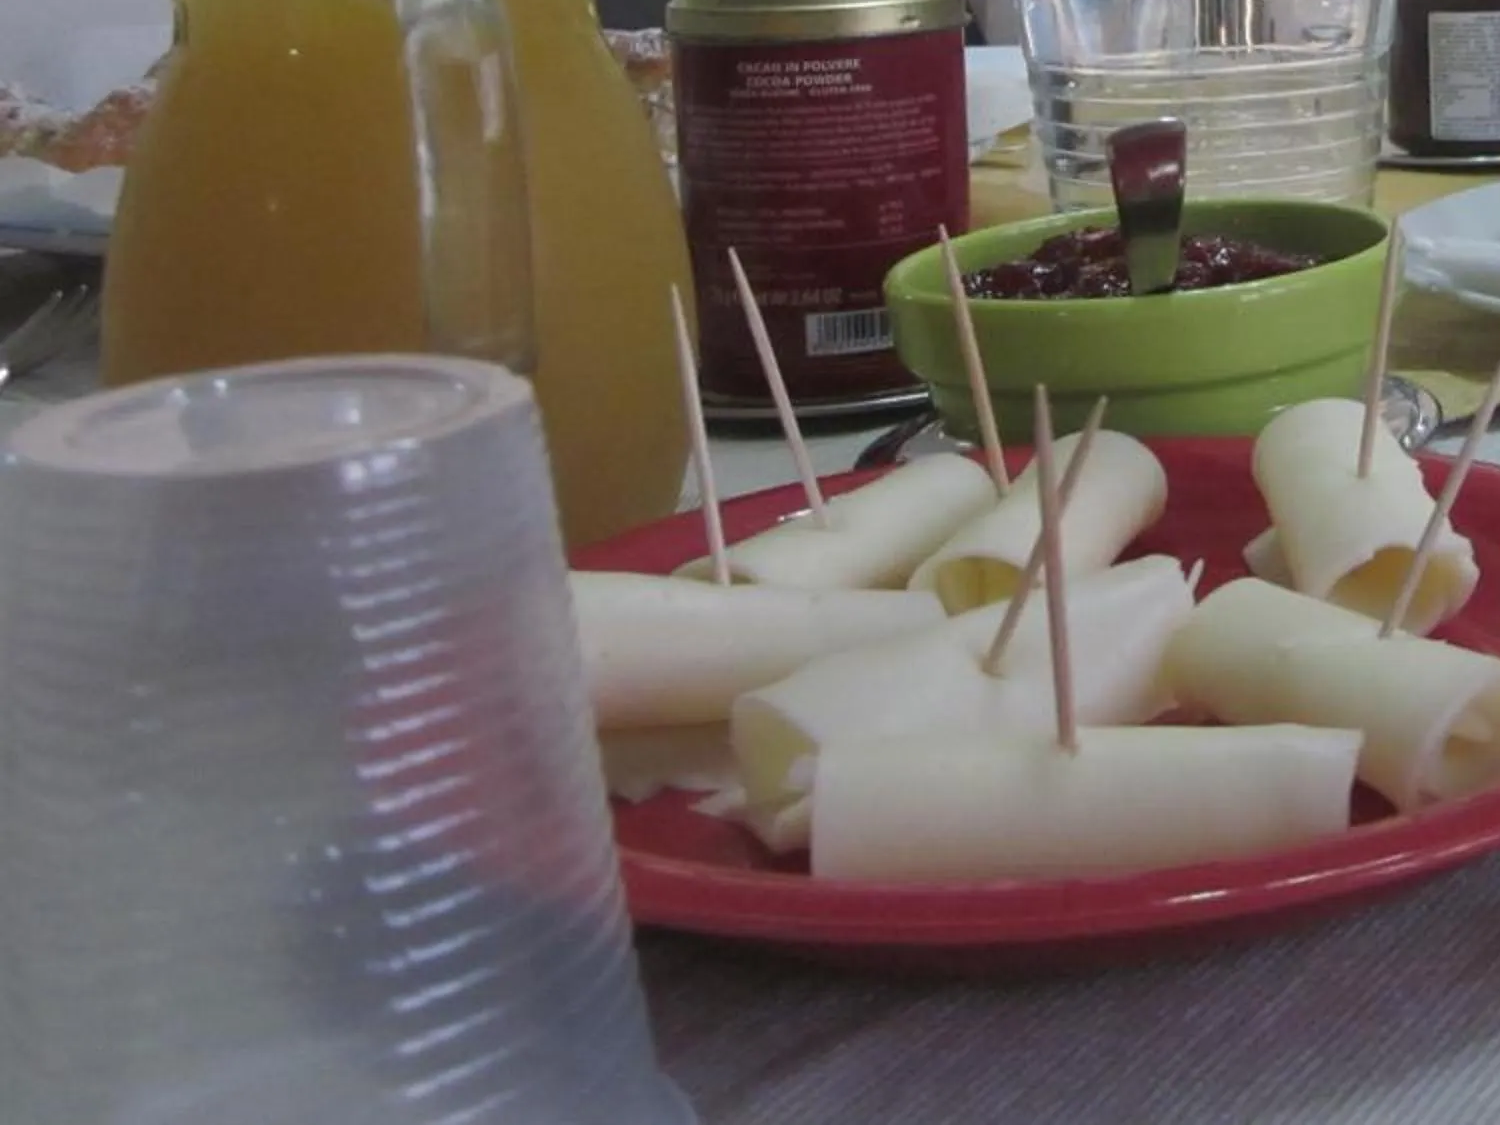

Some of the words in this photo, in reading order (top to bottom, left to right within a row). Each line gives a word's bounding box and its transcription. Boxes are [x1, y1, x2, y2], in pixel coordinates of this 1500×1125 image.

[736, 61, 782, 74] CACAO
[785, 62, 800, 73] IN
[803, 58, 861, 72] POLVERE
[746, 75, 791, 88] COCOA
[795, 73, 853, 87] POWDER
